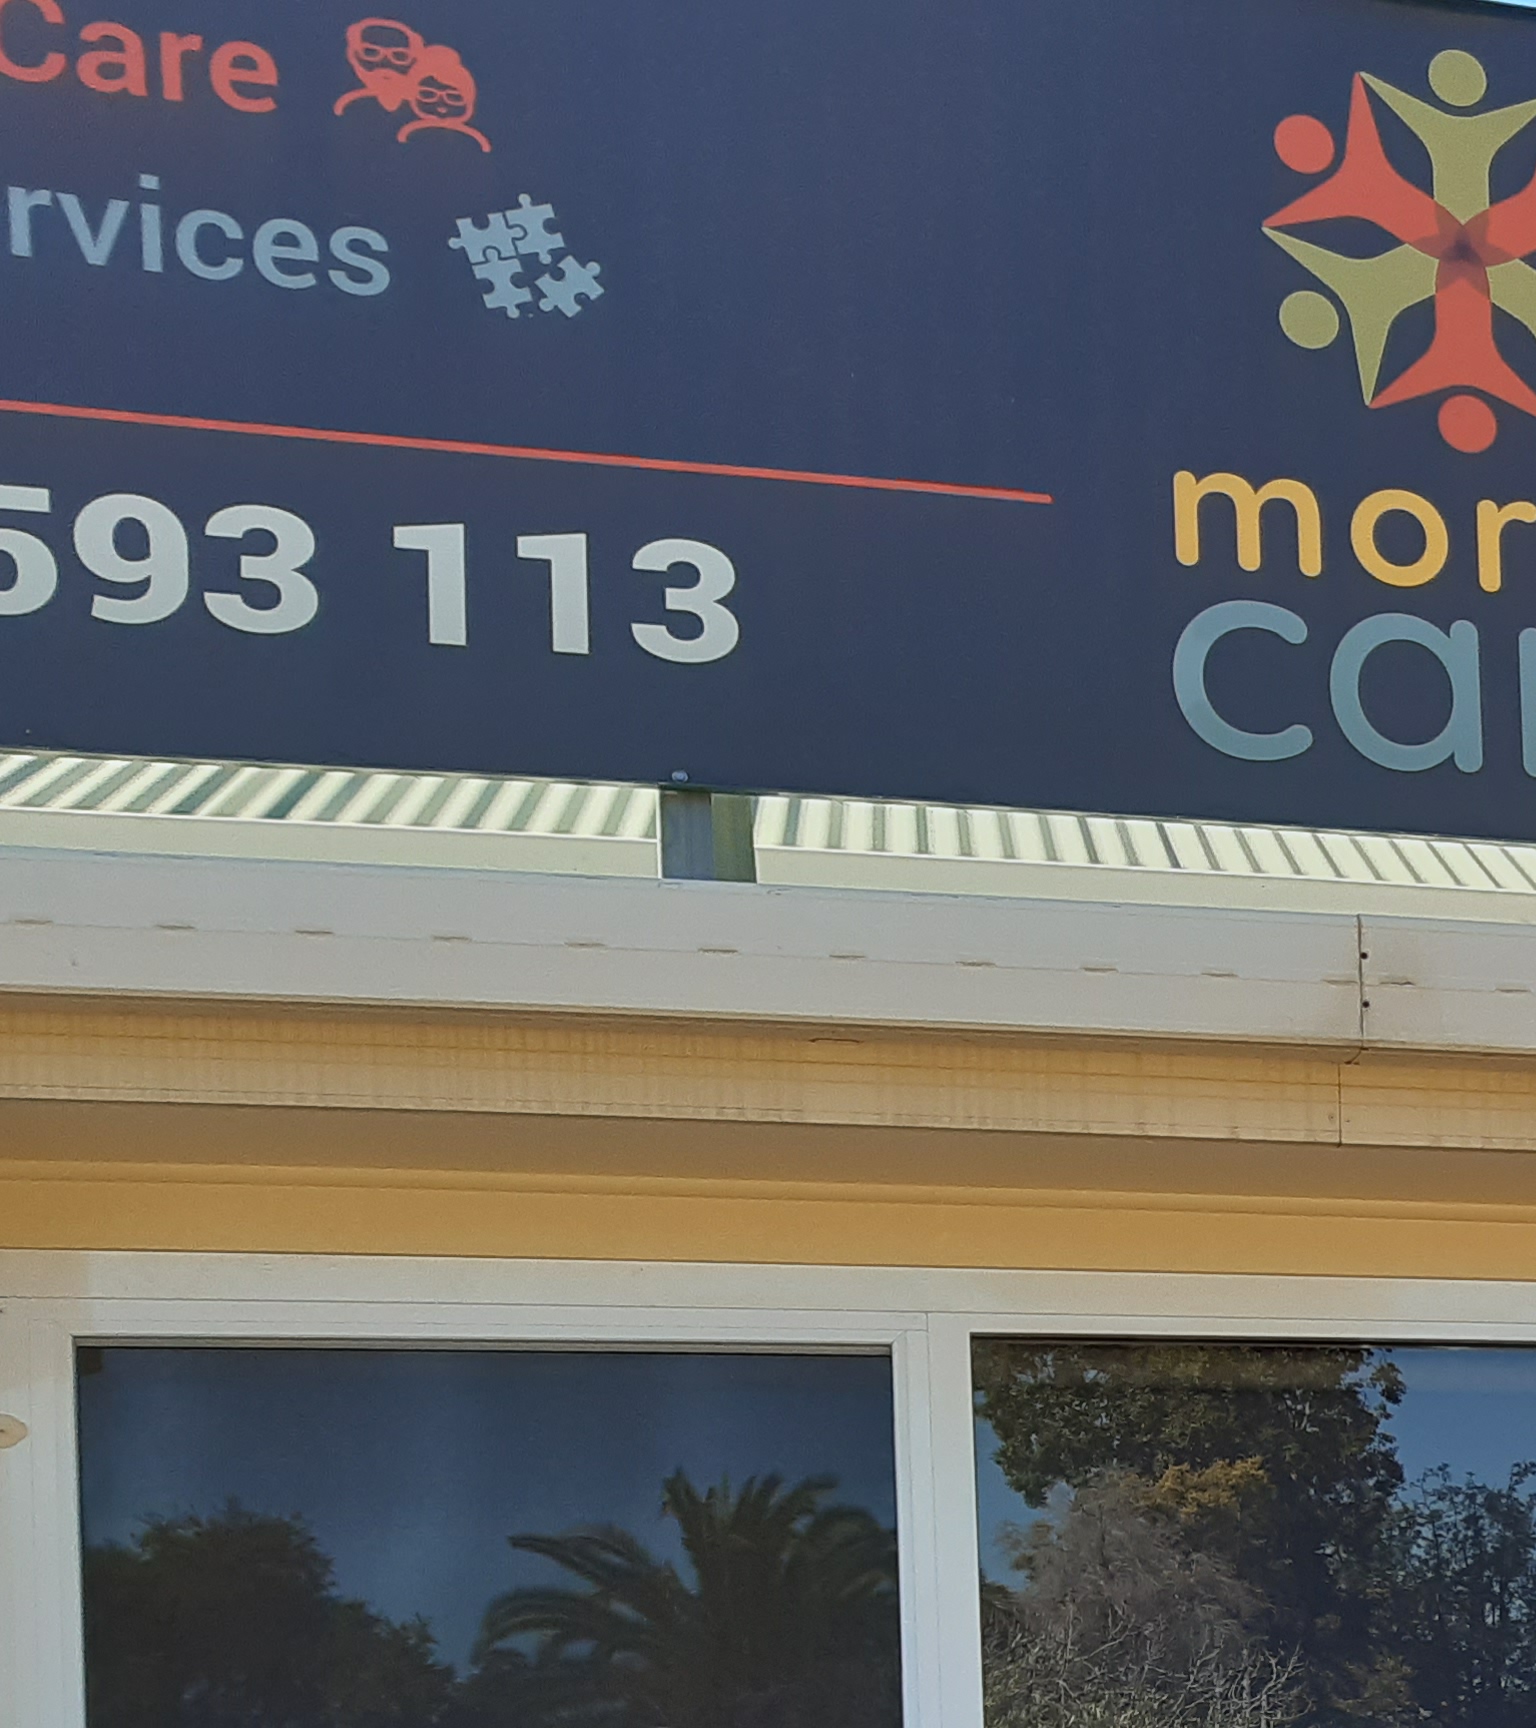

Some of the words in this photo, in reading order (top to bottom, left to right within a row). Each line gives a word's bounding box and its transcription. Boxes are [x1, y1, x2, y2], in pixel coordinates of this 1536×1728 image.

[0, 0, 278, 112] Care
[8, 173, 391, 296] rvices
[392, 523, 740, 663] 113
